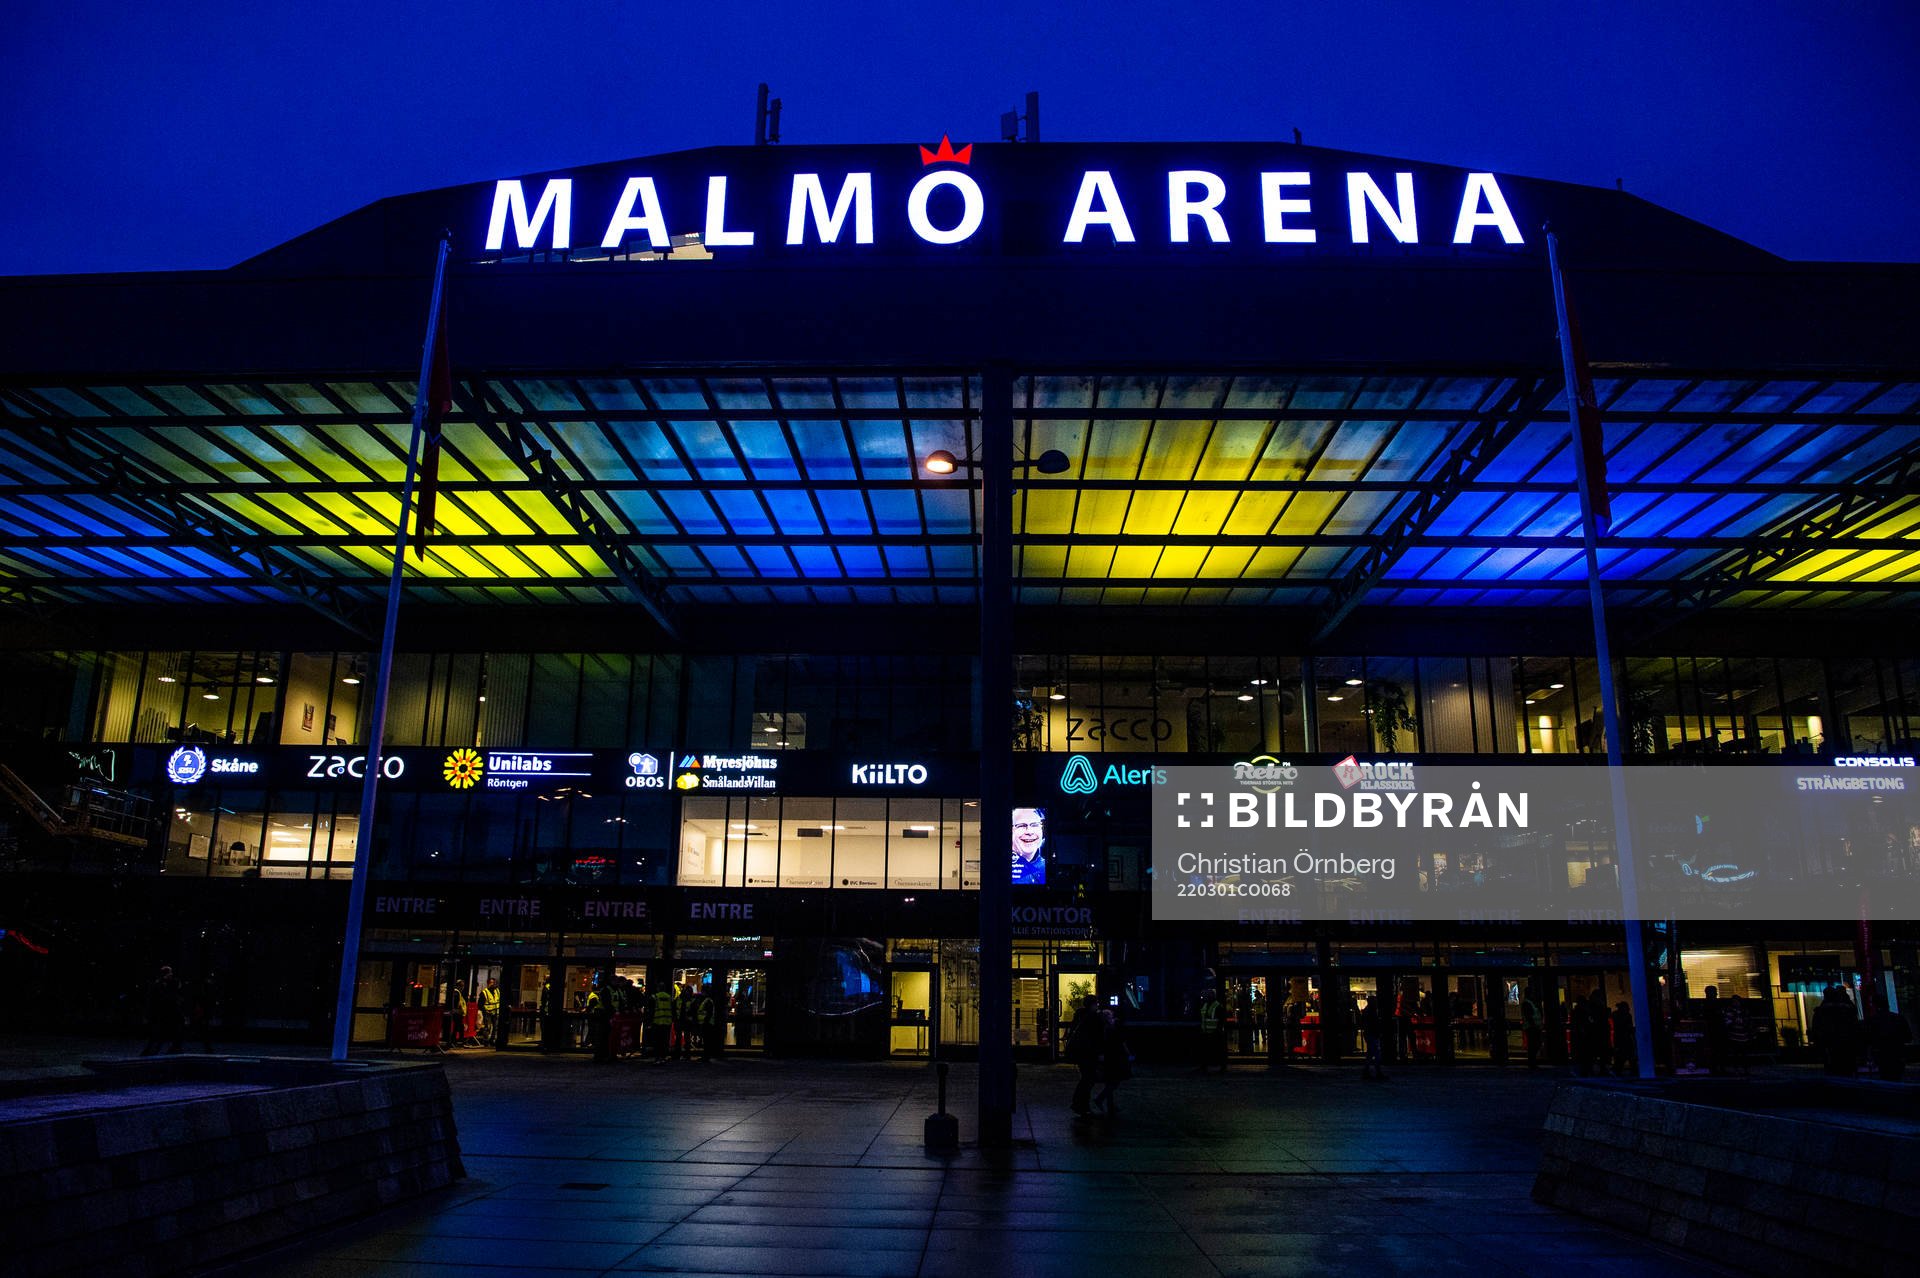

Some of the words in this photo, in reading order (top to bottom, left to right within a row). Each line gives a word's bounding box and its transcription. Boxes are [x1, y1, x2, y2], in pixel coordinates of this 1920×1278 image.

[1063, 170, 1525, 244] ARENA
[1066, 718, 1172, 741] zacco
[211, 758, 259, 773] Skåne
[489, 756, 553, 771] Unilabs
[703, 754, 778, 771] Myresjöhus
[1233, 761, 1298, 780] Retro
[1834, 757, 1916, 767] CONSOLIS
[1103, 764, 1168, 785] Aleris
[1359, 762, 1415, 780] ROCK
[487, 778, 528, 790] Röntgen
[625, 776, 665, 788] OBOS
[1360, 780, 1416, 790] KLASSIKER
[1796, 774, 1905, 790] STRÄNGBETONG
[375, 897, 438, 914] ENTRE
[479, 898, 541, 916] ENTRE
[584, 900, 647, 918] ENTRE
[689, 902, 753, 920] ENTRE
[1011, 906, 1093, 924] KONTOR
[1568, 909, 1622, 926] ENTR
